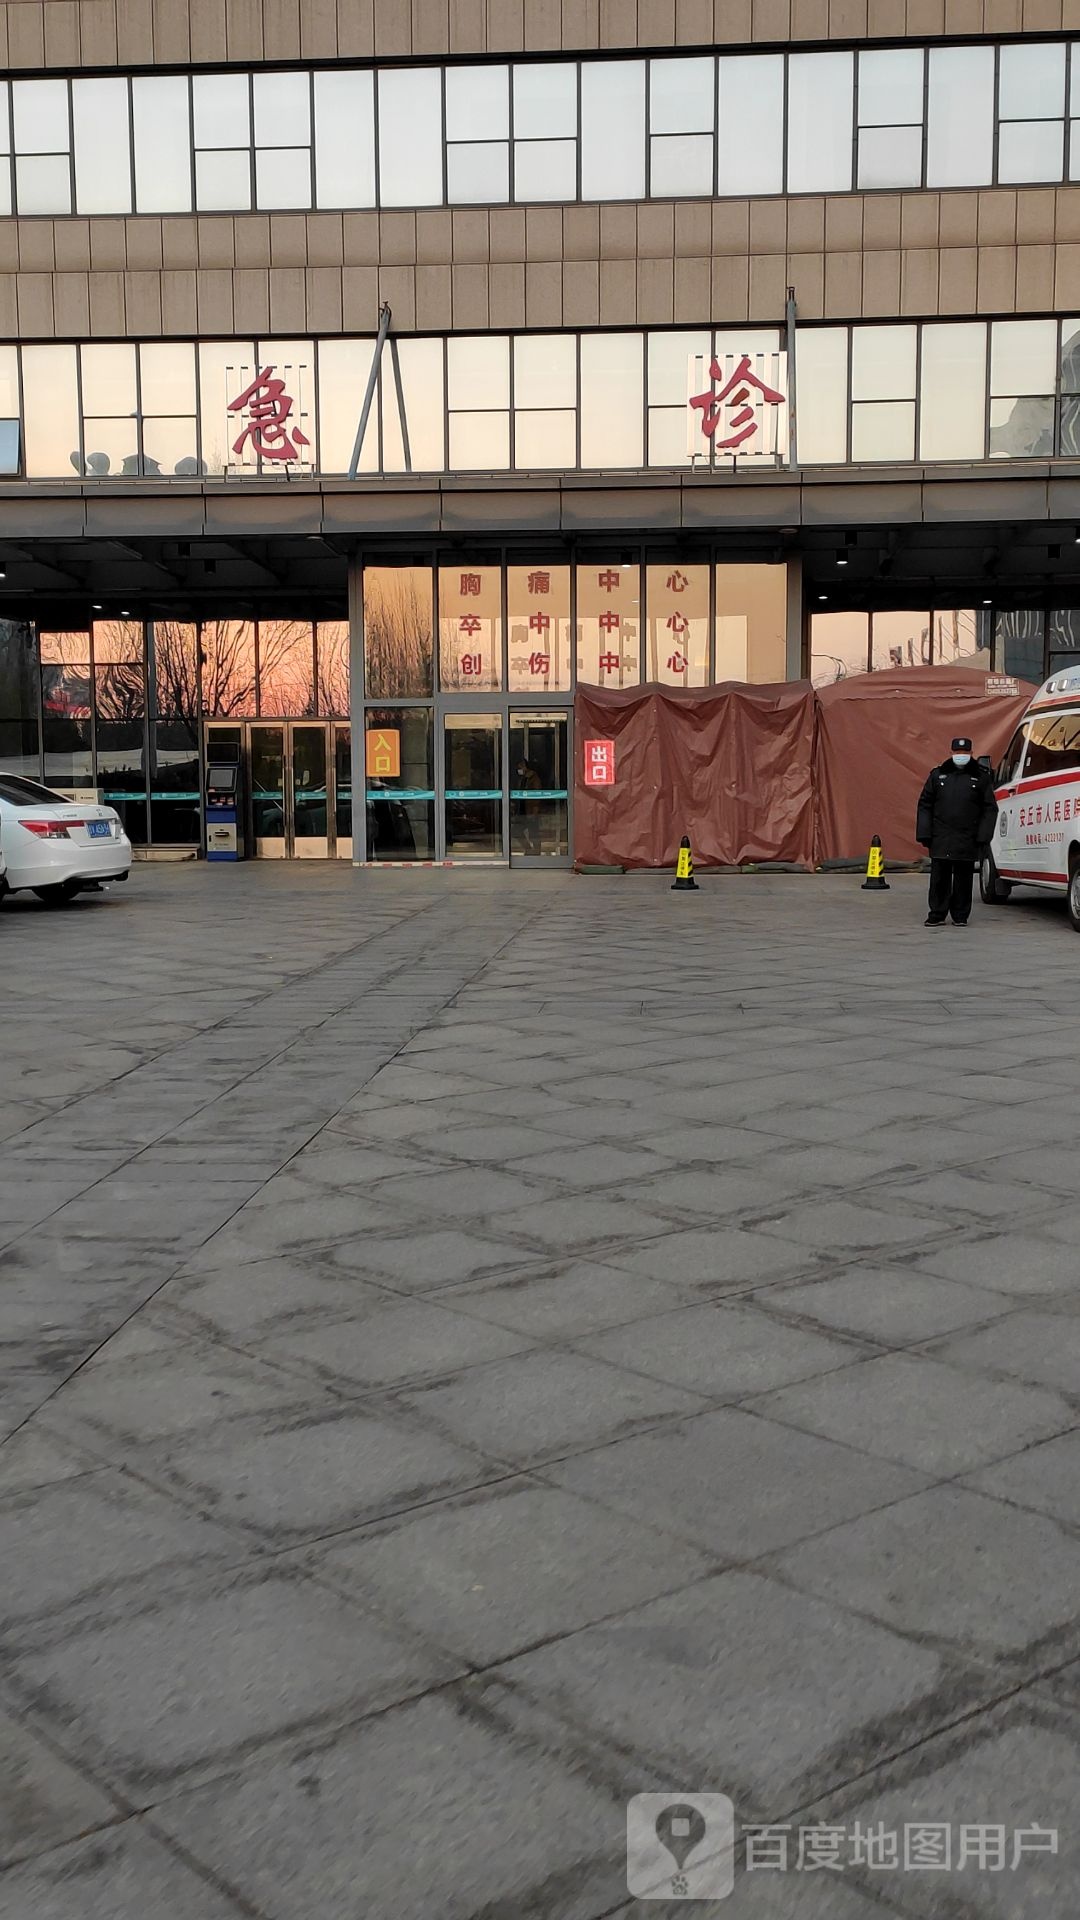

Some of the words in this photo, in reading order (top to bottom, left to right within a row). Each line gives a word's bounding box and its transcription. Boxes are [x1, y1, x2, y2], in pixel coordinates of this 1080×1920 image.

[226, 366, 311, 460] 急
[689, 356, 786, 449] 诊
[459, 569, 689, 597] 胸痛中心
[459, 611, 689, 637] 卒中中心
[460, 651, 689, 676] 创伤中心
[374, 733, 392, 773] 入口
[591, 745, 607, 780] 出口
